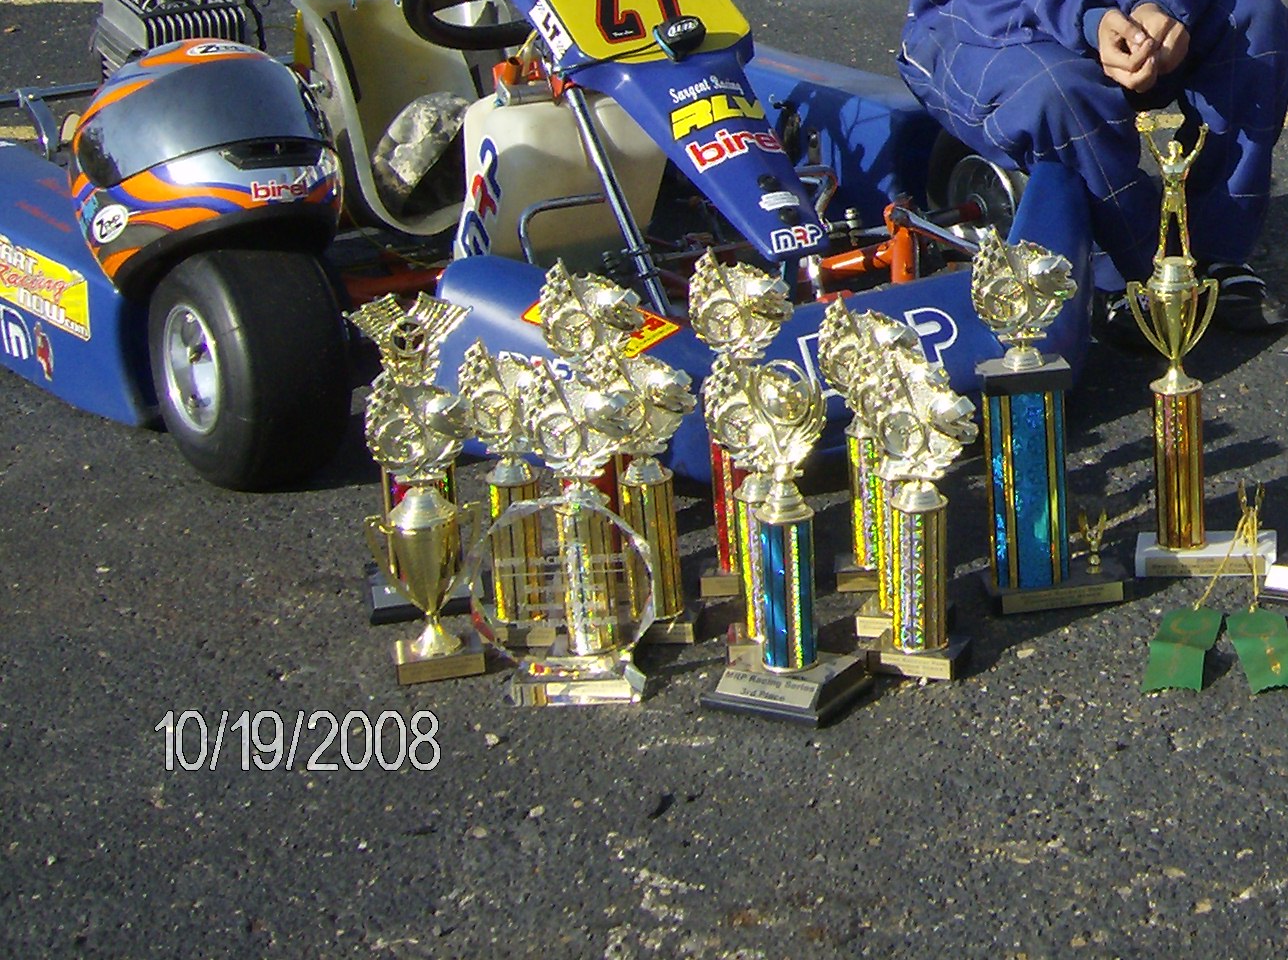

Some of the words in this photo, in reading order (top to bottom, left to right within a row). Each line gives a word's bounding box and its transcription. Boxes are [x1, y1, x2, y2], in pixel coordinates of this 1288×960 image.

[668, 78, 712, 104] Sargent
[669, 92, 766, 141] RLV
[250, 179, 309, 202] birel
[0, 240, 38, 276] ART
